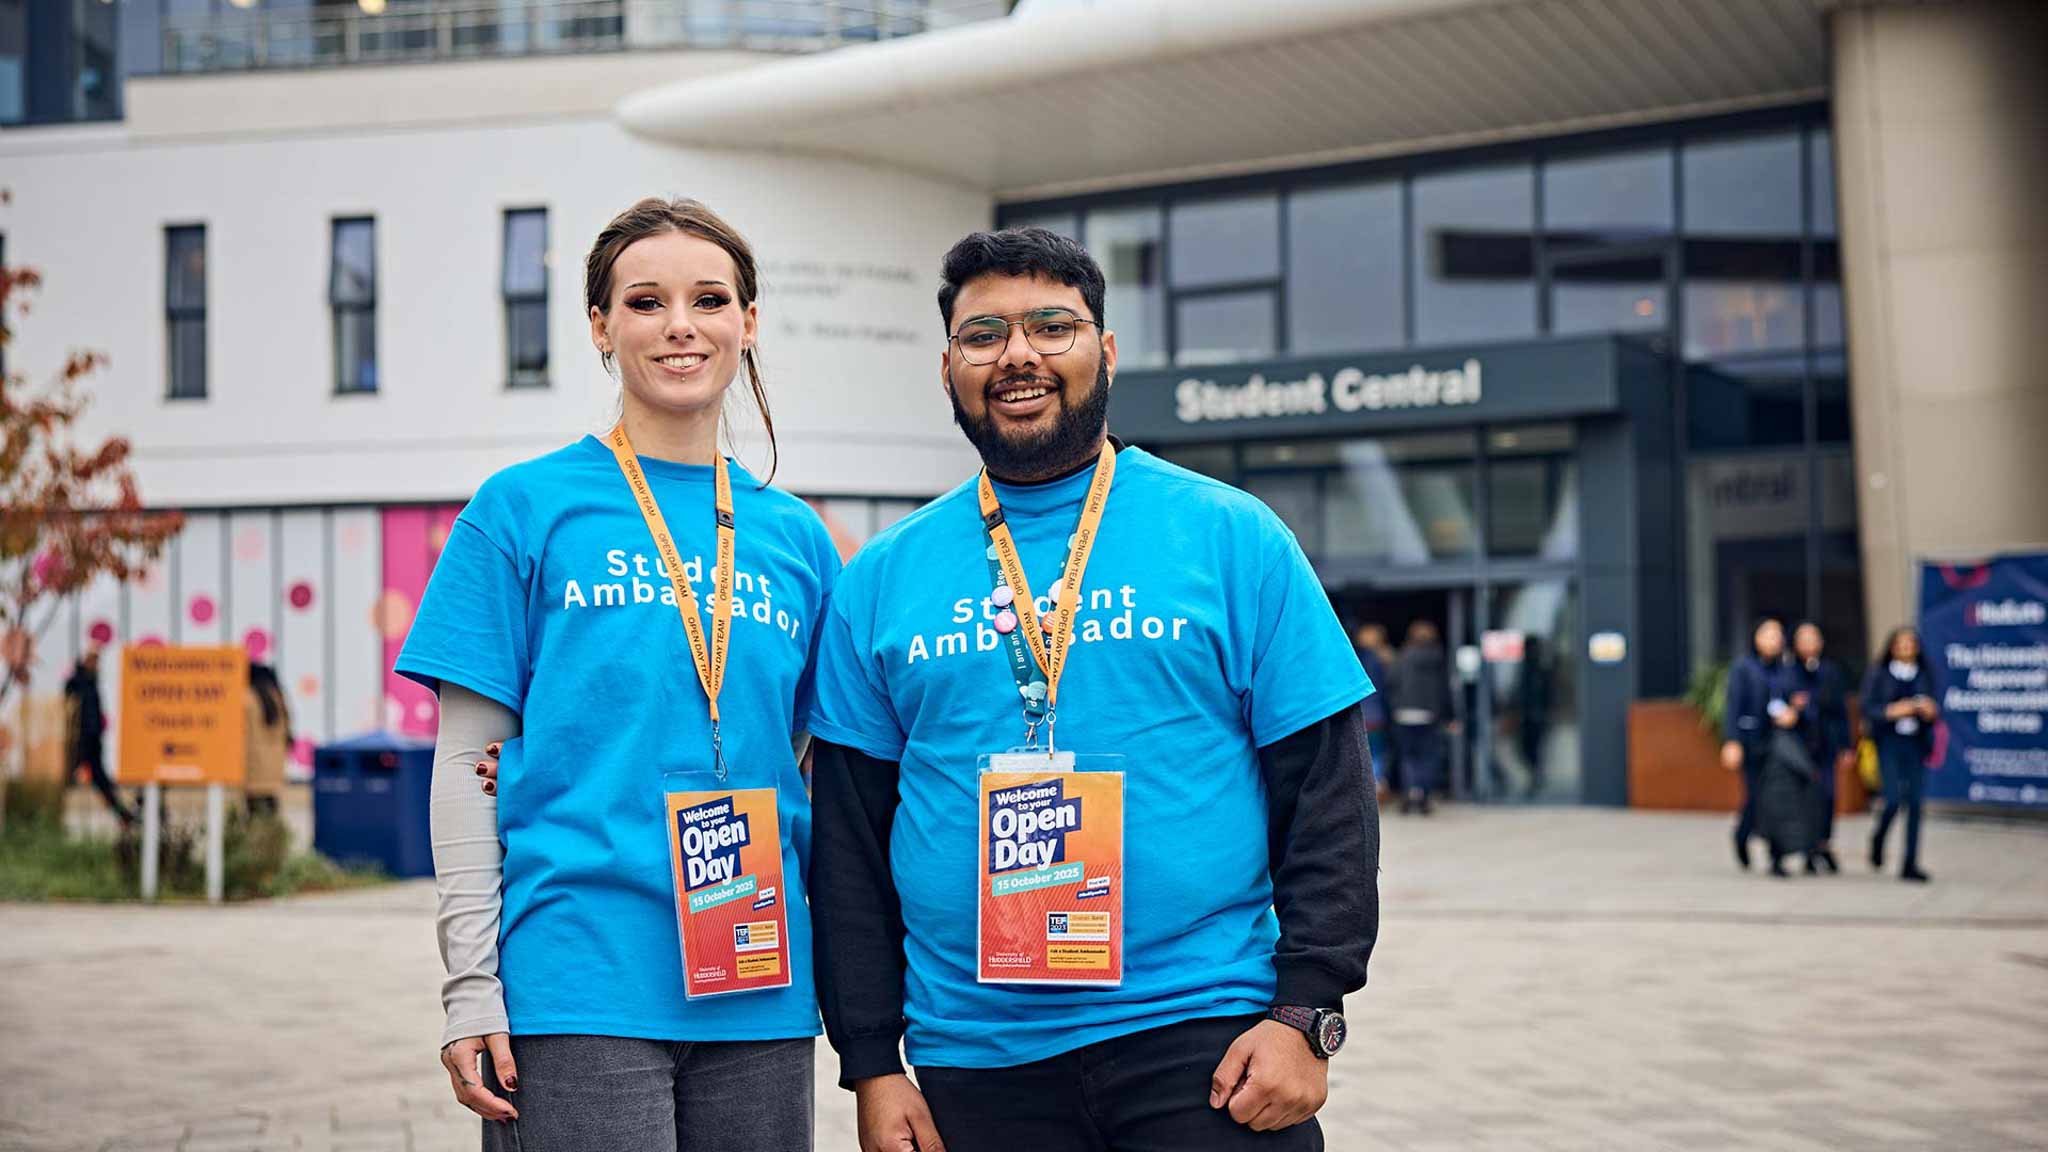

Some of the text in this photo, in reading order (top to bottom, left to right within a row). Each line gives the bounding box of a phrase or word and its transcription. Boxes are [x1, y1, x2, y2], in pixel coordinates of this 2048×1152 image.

[1175, 358, 1482, 422] Student Central
[624, 458, 656, 517] OPEN DAY TEAM
[1088, 491, 1101, 513] TEAM
[657, 532, 690, 598] OPEN DAY TEAM
[719, 538, 729, 600] OPEN DAY TEAM
[997, 536, 1025, 596] OPEN DAY TEAM
[1064, 528, 1091, 590] OPEN DAY TEAM
[564, 577, 799, 639] Ambasador
[952, 584, 1136, 624] Stdnt
[715, 619, 725, 643] TEAM
[1021, 610, 1037, 635] TEAM
[1055, 608, 1070, 635] OPEN
[686, 615, 701, 642] OPEN
[694, 642, 706, 662] DAY
[907, 610, 1187, 664] Ambador
[1030, 634, 1041, 653] DAY
[1053, 635, 1064, 655] DAY
[713, 643, 723, 663] DAY
[138, 682, 226, 700] OPEN DAY
[996, 786, 1057, 805] Welcome
[1030, 799, 1052, 811] your
[682, 804, 730, 824] Welcome
[701, 816, 727, 828] to your
[992, 804, 1075, 844] Open
[682, 820, 746, 861] Open
[995, 838, 1057, 870] Day
[687, 853, 735, 887] Day
[997, 867, 1079, 890] 15 October 2025
[693, 897, 703, 907] 15
[704, 887, 735, 904] October
[736, 880, 754, 894] 2025
